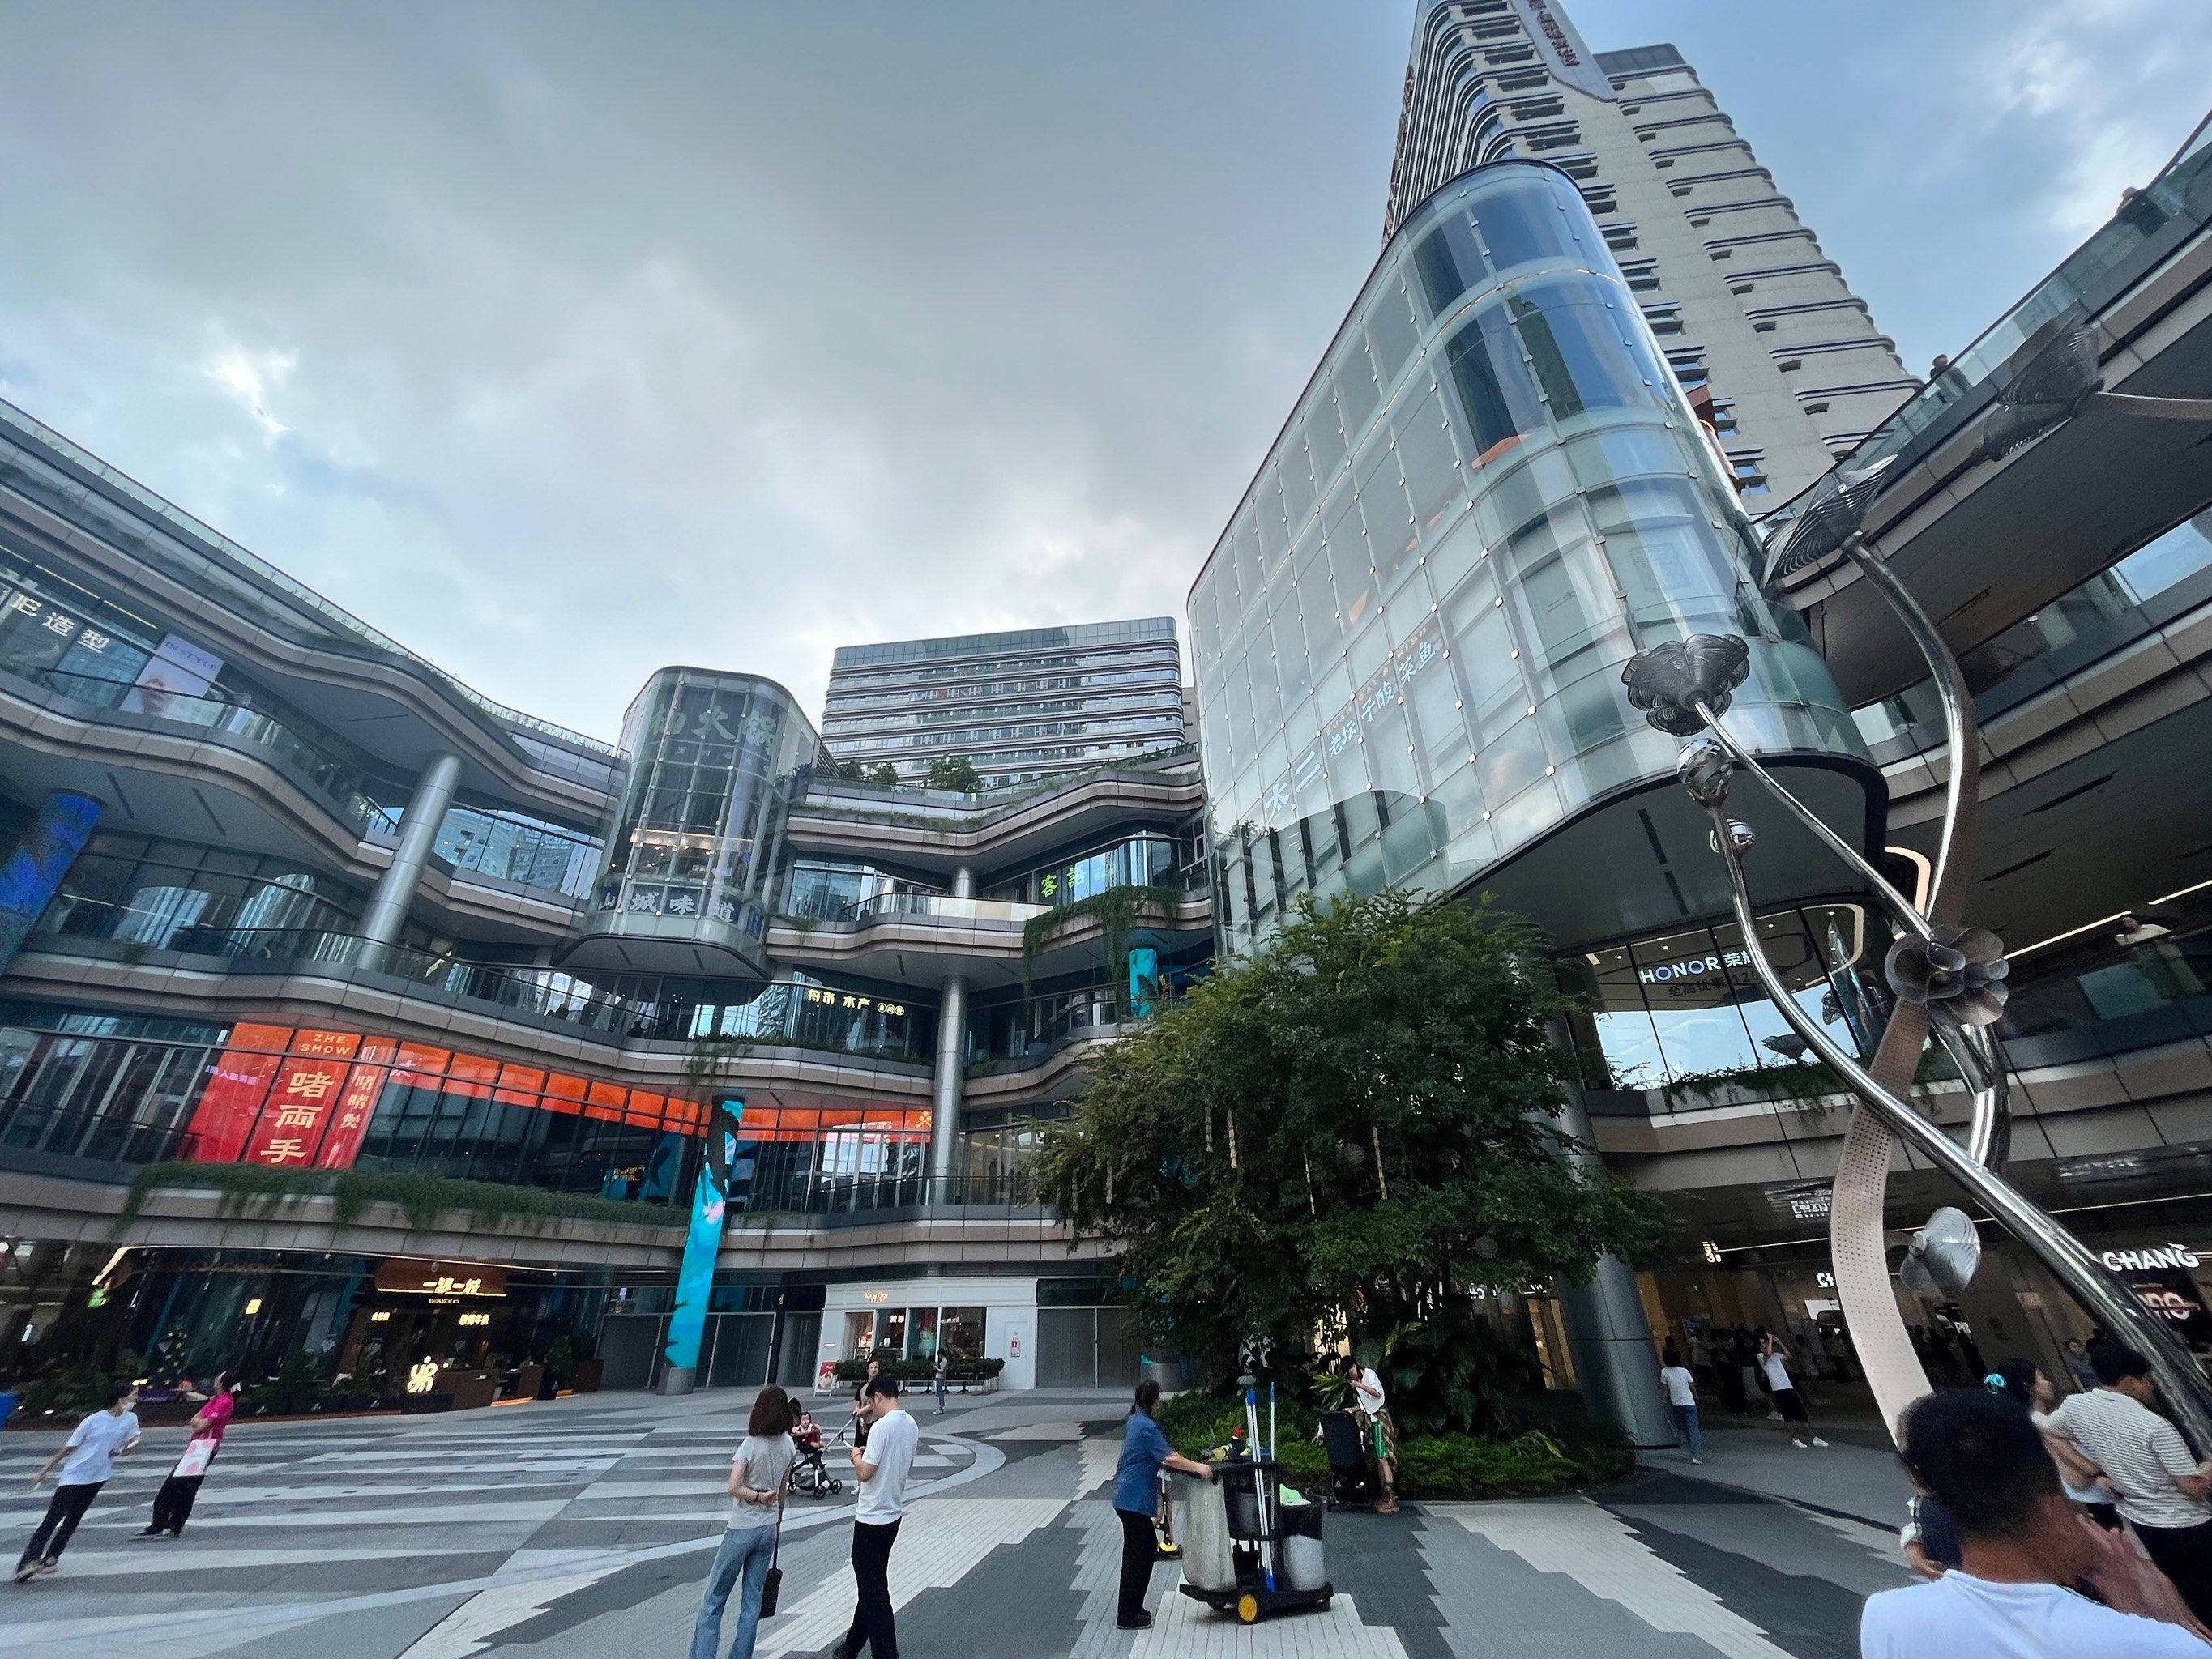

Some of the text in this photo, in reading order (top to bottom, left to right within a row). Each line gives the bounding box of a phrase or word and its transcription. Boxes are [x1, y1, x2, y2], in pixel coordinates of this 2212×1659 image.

[1639, 957, 1722, 985] HONOR
[312, 1034, 347, 1044] ZHE
[300, 1043, 351, 1056] SHOW
